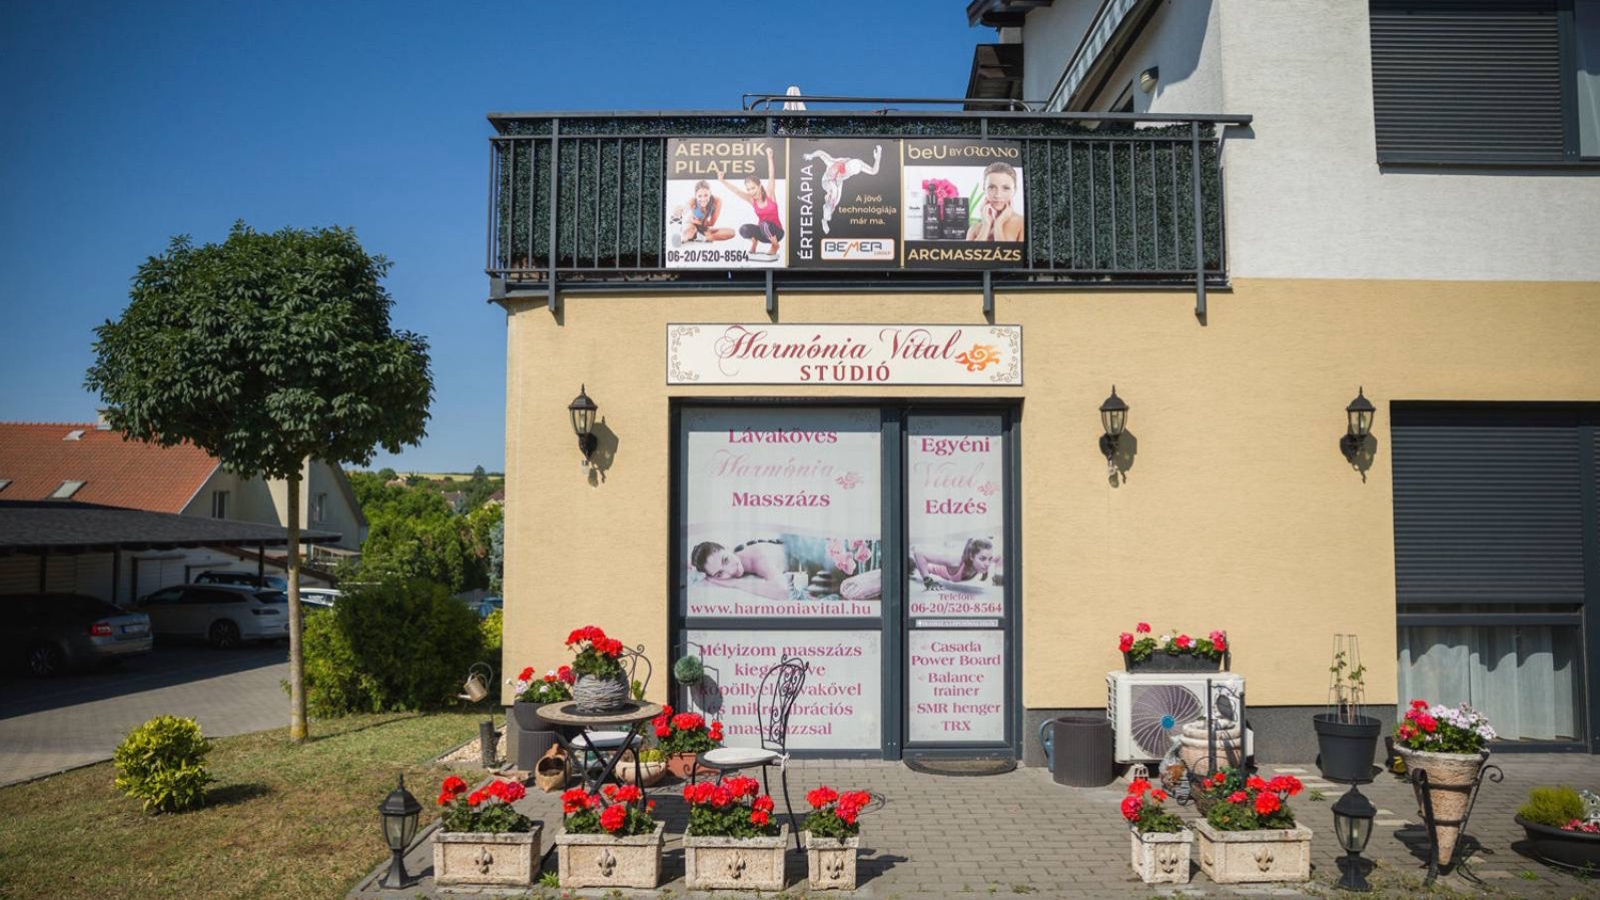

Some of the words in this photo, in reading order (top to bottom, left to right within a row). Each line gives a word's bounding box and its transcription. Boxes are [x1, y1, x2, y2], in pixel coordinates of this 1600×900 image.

[675, 142, 766, 157] AEROBIK
[908, 144, 947, 159] beU
[949, 148, 962, 157] BY
[964, 145, 1019, 158] ORGANO
[675, 160, 756, 174] PILATES
[855, 194, 862, 202] A
[797, 164, 813, 260] ÉRTERÁPIA
[838, 206, 897, 215] technológiája
[850, 217, 868, 225] már
[667, 250, 750, 262] 06-20/520-8564
[824, 241, 883, 257] BEMER
[908, 247, 1022, 261] ARCMASSZÁZS
[714, 324, 873, 372] Harmónia
[879, 327, 962, 360] Vital
[800, 361, 890, 382] STÚDIÓ
[921, 435, 991, 456] Egyéni
[732, 491, 831, 507] Masszázs
[925, 497, 987, 515] Edzés
[690, 602, 872, 615] www.harmoniavital.hu
[911, 602, 1002, 615] 06-20/520-8564
[699, 642, 776, 660] Mélyizom
[782, 643, 862, 657] masszázs
[931, 641, 982, 653] Casada
[911, 655, 955, 666] Power
[960, 654, 1001, 666] Board
[928, 672, 984, 683] Balance
[933, 685, 981, 697] trainer
[916, 703, 949, 714] SMR
[953, 702, 1002, 716] henger
[941, 720, 971, 731] TRX
